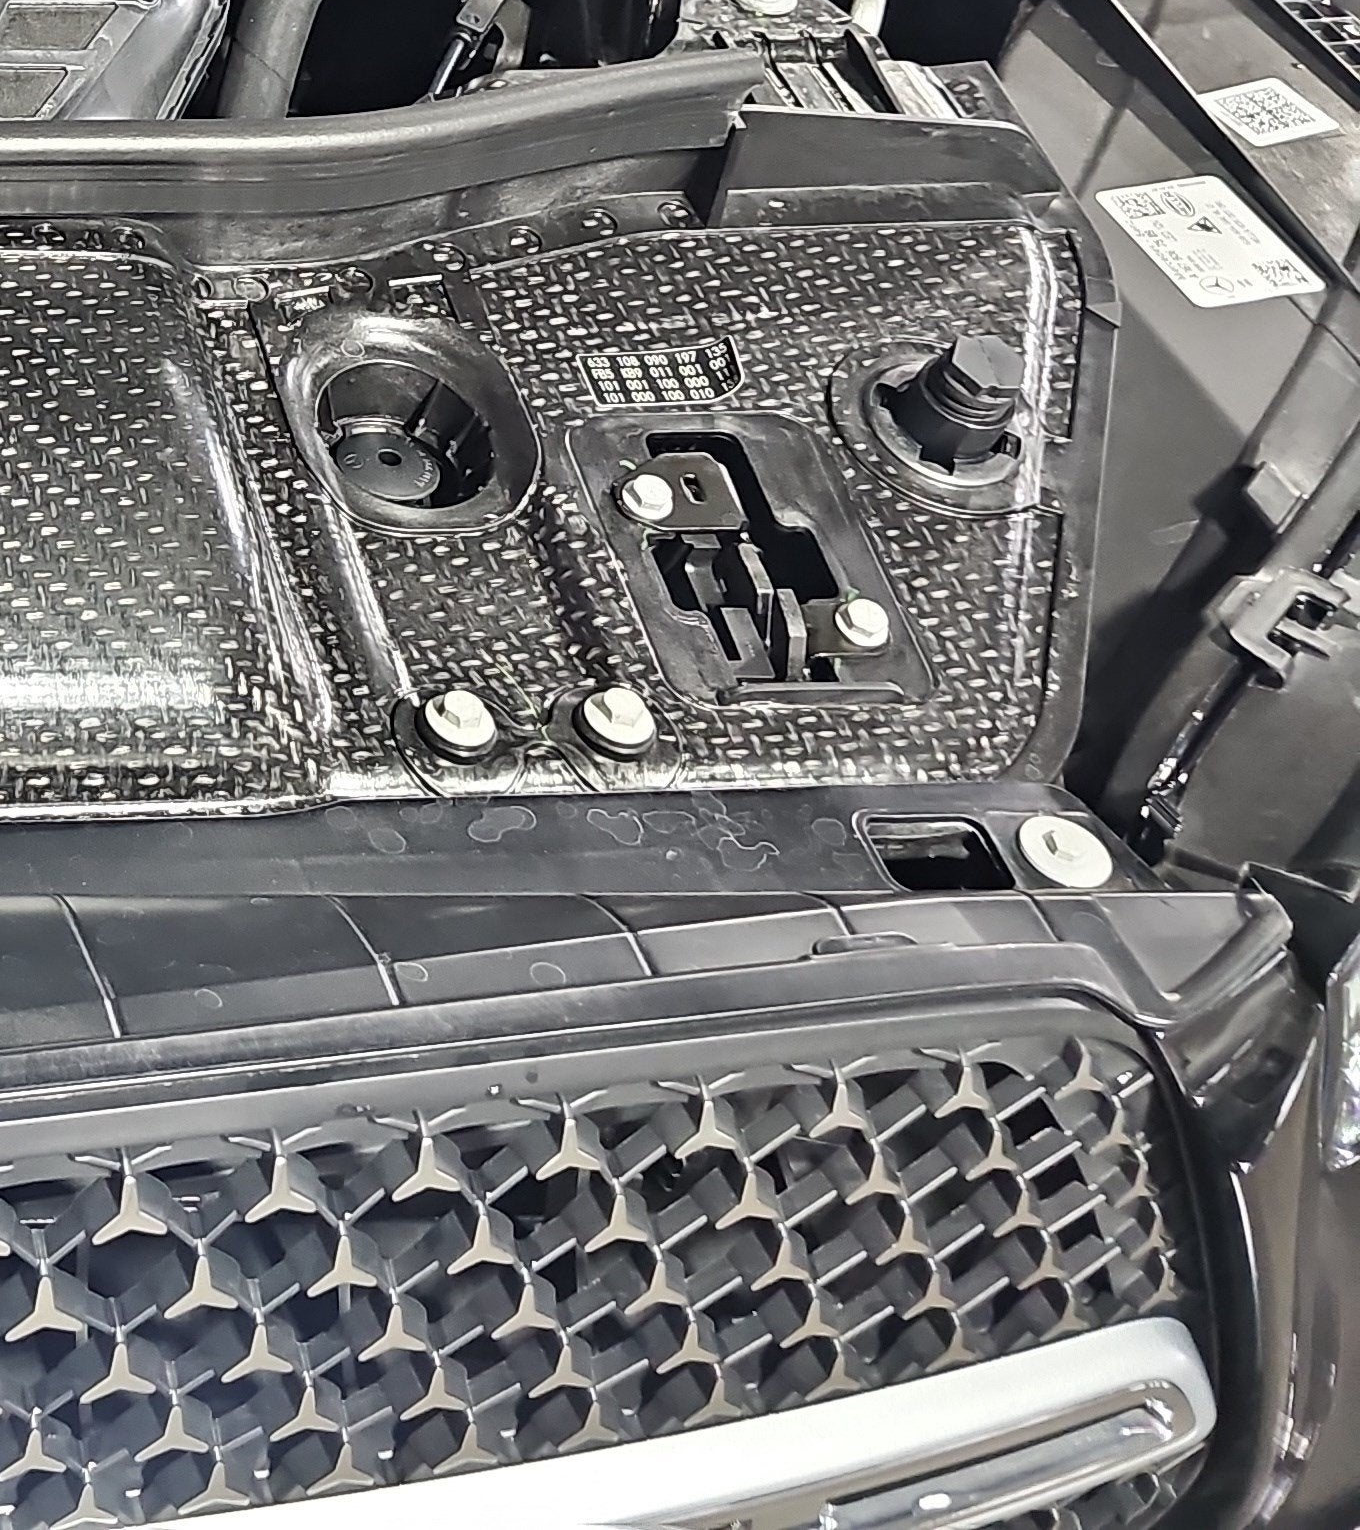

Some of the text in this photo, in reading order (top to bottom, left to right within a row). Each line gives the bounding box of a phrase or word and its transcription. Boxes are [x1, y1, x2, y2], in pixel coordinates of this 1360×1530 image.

[587, 343, 727, 368] 633 108 090 197 135
[649, 366, 674, 378] 011
[679, 364, 704, 377] 001
[708, 353, 730, 370] 001
[598, 380, 621, 392] 101
[626, 379, 650, 390] 001
[656, 378, 680, 389] 100
[684, 375, 710, 388] 000
[603, 392, 626, 403] 101
[631, 391, 656, 402] 000
[661, 390, 686, 401] 100
[690, 387, 715, 399] 010
